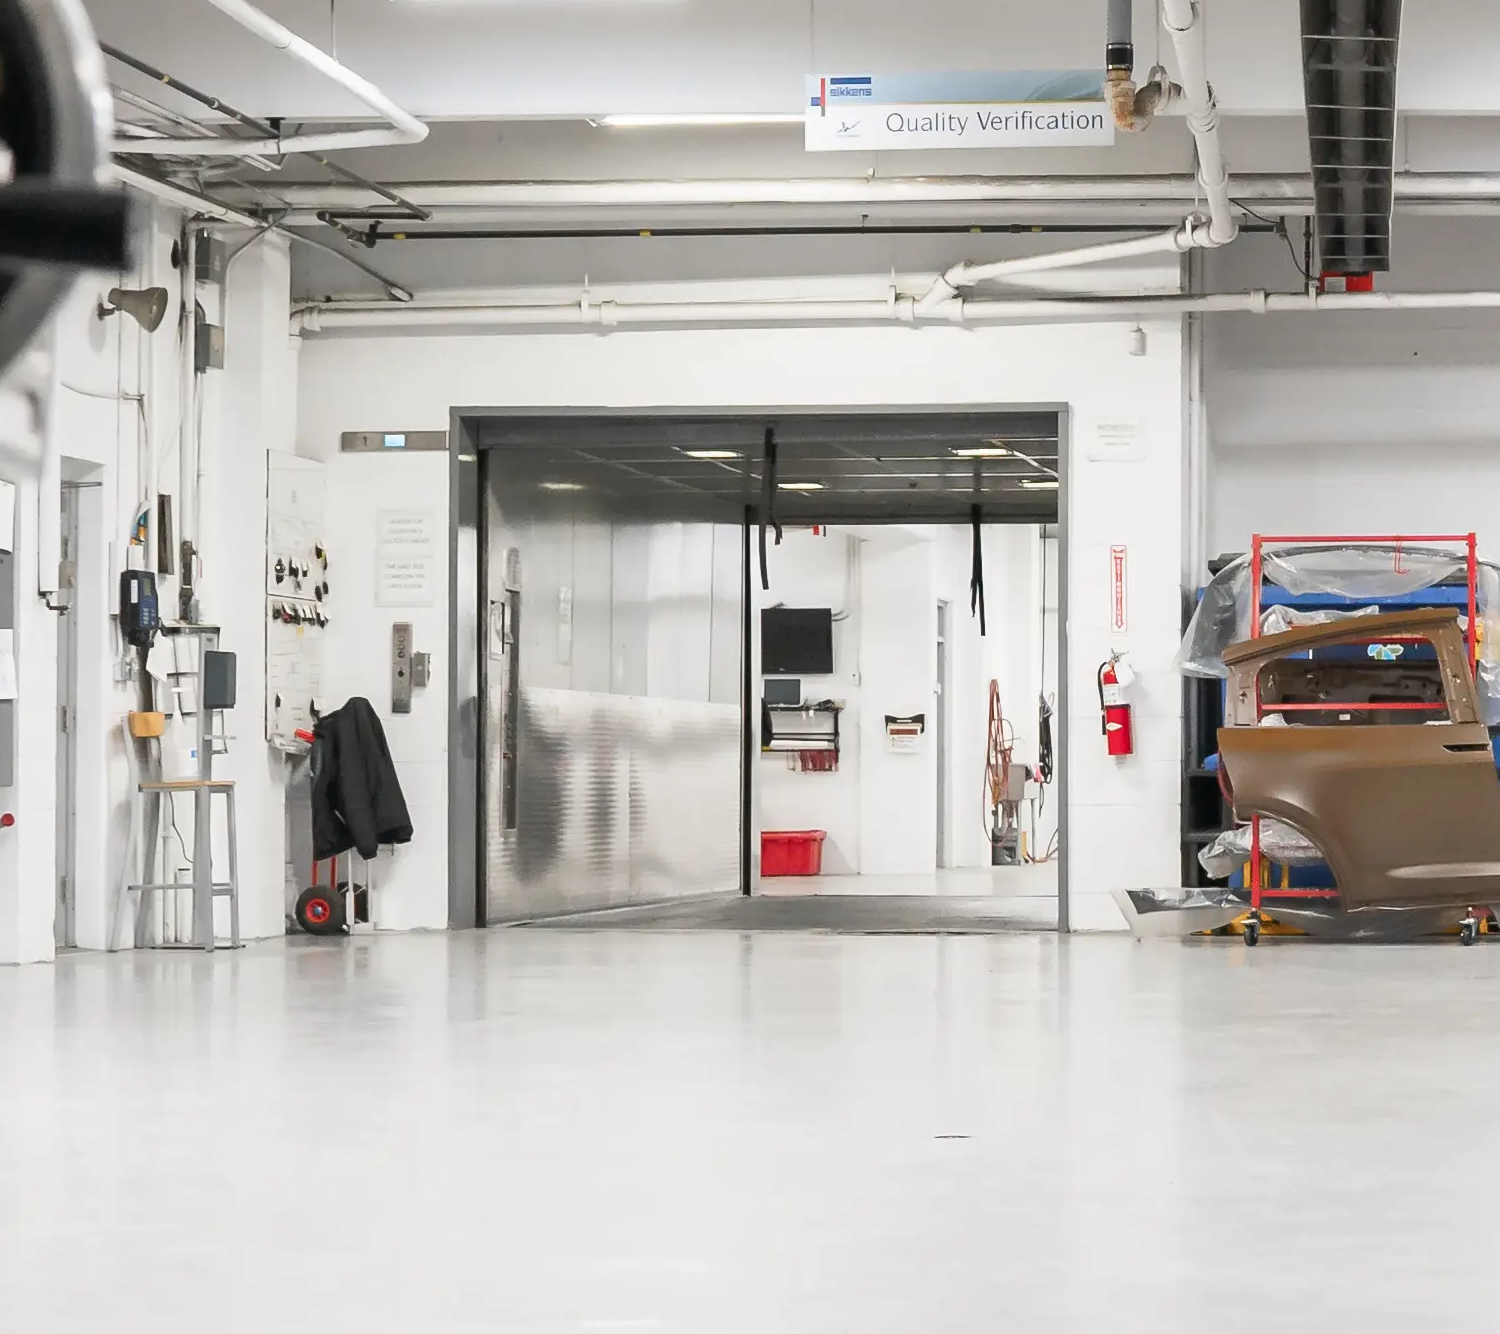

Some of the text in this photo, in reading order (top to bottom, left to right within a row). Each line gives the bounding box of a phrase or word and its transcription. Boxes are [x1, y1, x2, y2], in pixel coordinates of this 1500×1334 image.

[830, 86, 872, 97] sikkens
[886, 110, 1104, 136] Quality Verification
